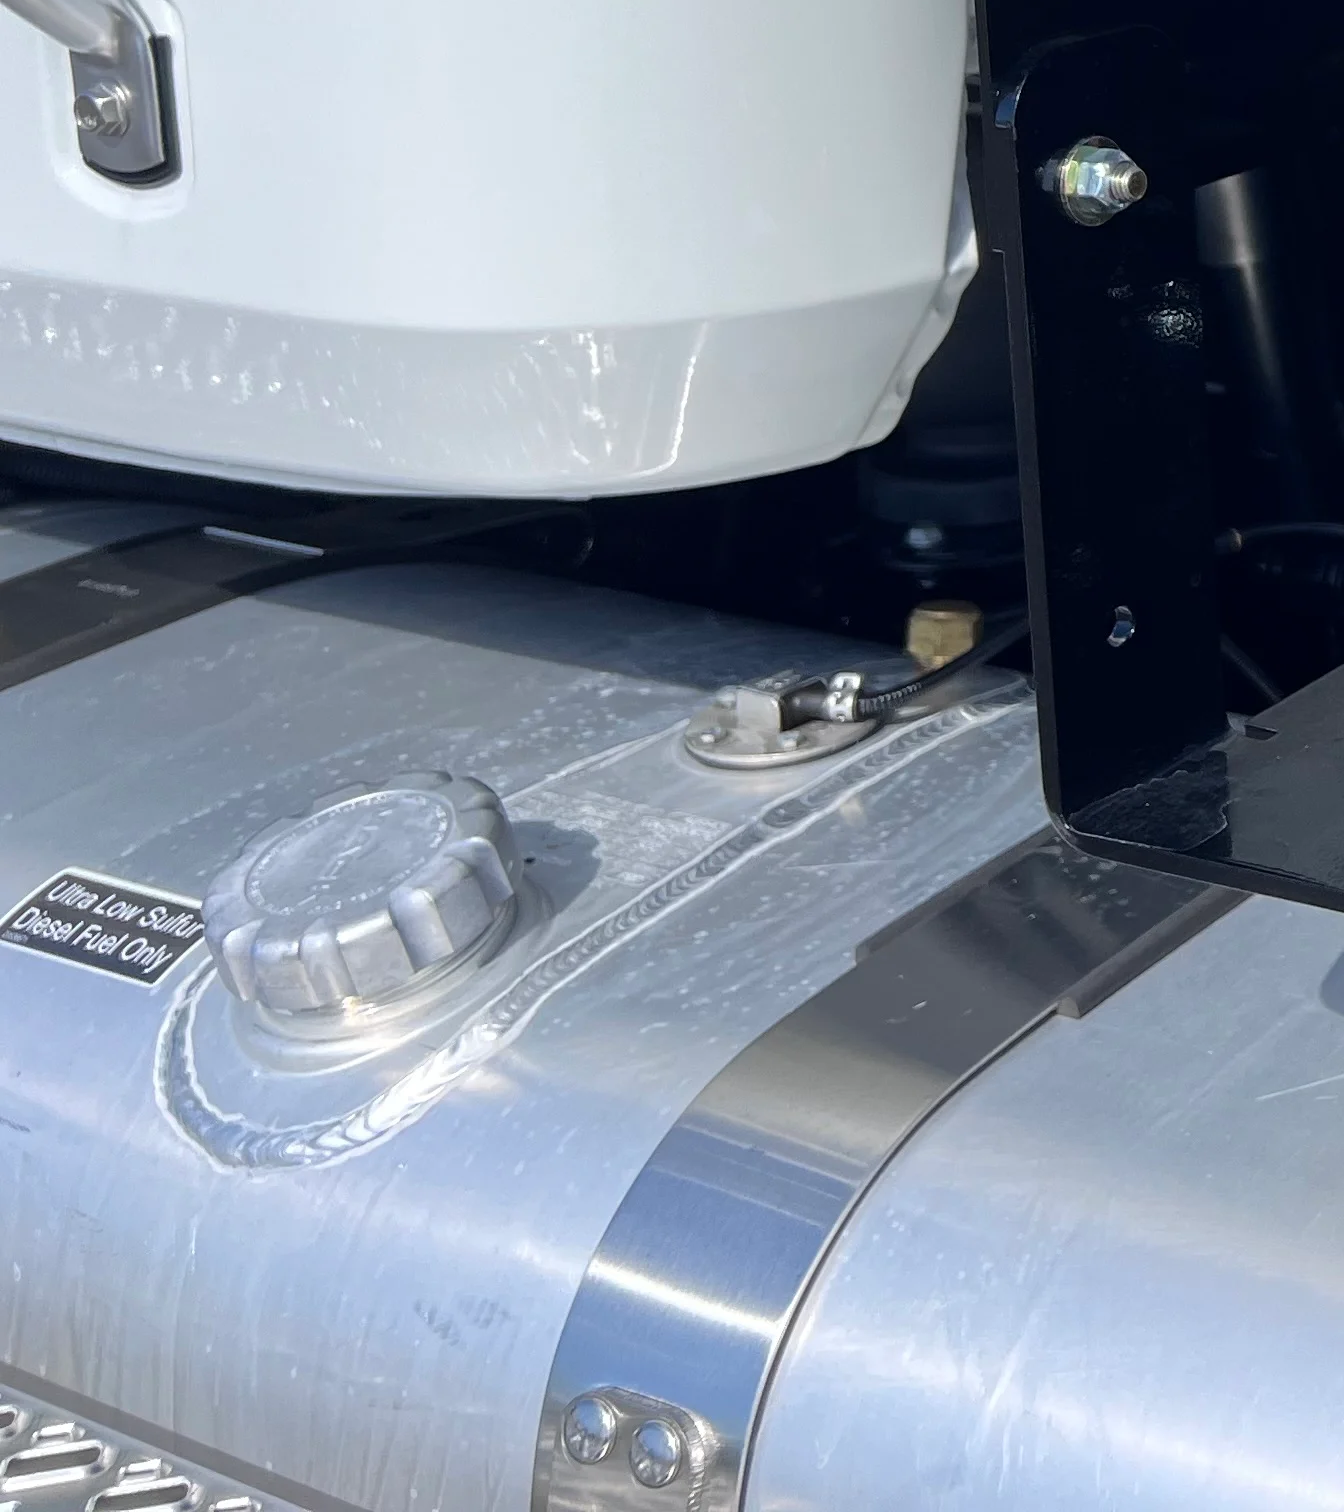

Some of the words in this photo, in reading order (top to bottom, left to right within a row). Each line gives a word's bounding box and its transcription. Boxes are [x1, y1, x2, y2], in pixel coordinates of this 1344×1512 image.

[11, 906, 84, 943] Diesel
[71, 923, 130, 956] Fuel
[118, 932, 174, 975] Only
[46, 879, 98, 910] Ultra
[91, 893, 144, 923] Low
[137, 904, 205, 940] Sulfur
